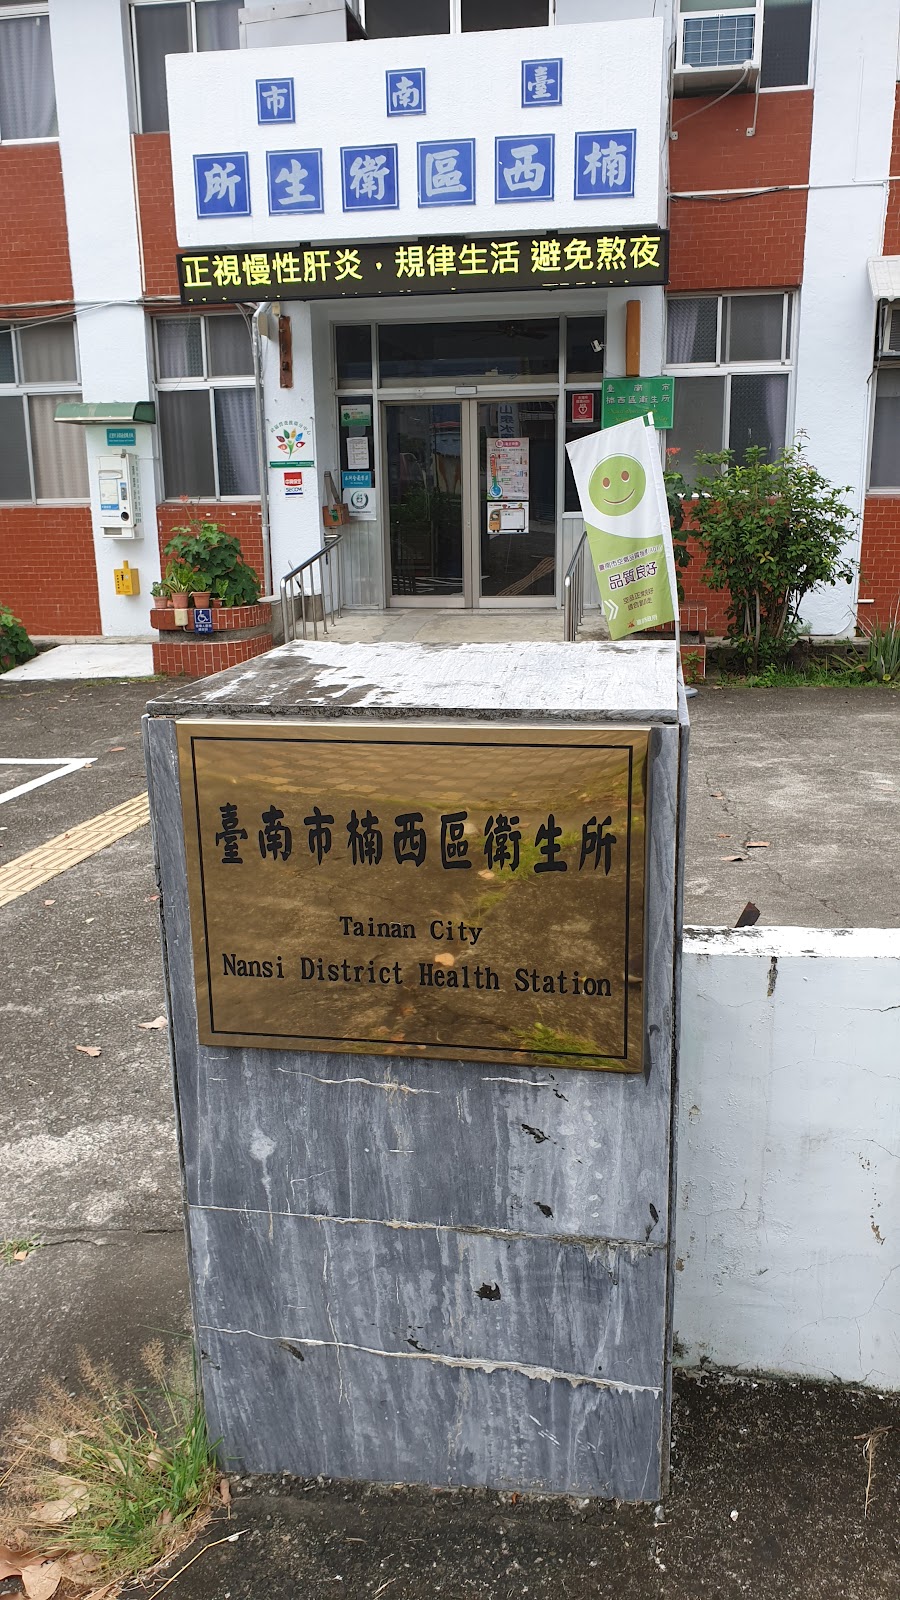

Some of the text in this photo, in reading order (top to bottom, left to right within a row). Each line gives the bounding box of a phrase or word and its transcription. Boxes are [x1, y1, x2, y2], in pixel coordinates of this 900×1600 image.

[261, 66, 555, 117] 臺南市
[203, 141, 631, 207] 楠西區衛生所
[531, 234, 661, 273] 避免熬夜
[609, 561, 658, 590] 品質良好
[215, 802, 618, 876] 臺南市楠西區衛生所
[340, 916, 483, 945] Tainan City
[222, 953, 612, 997] Nansi District Health Station
